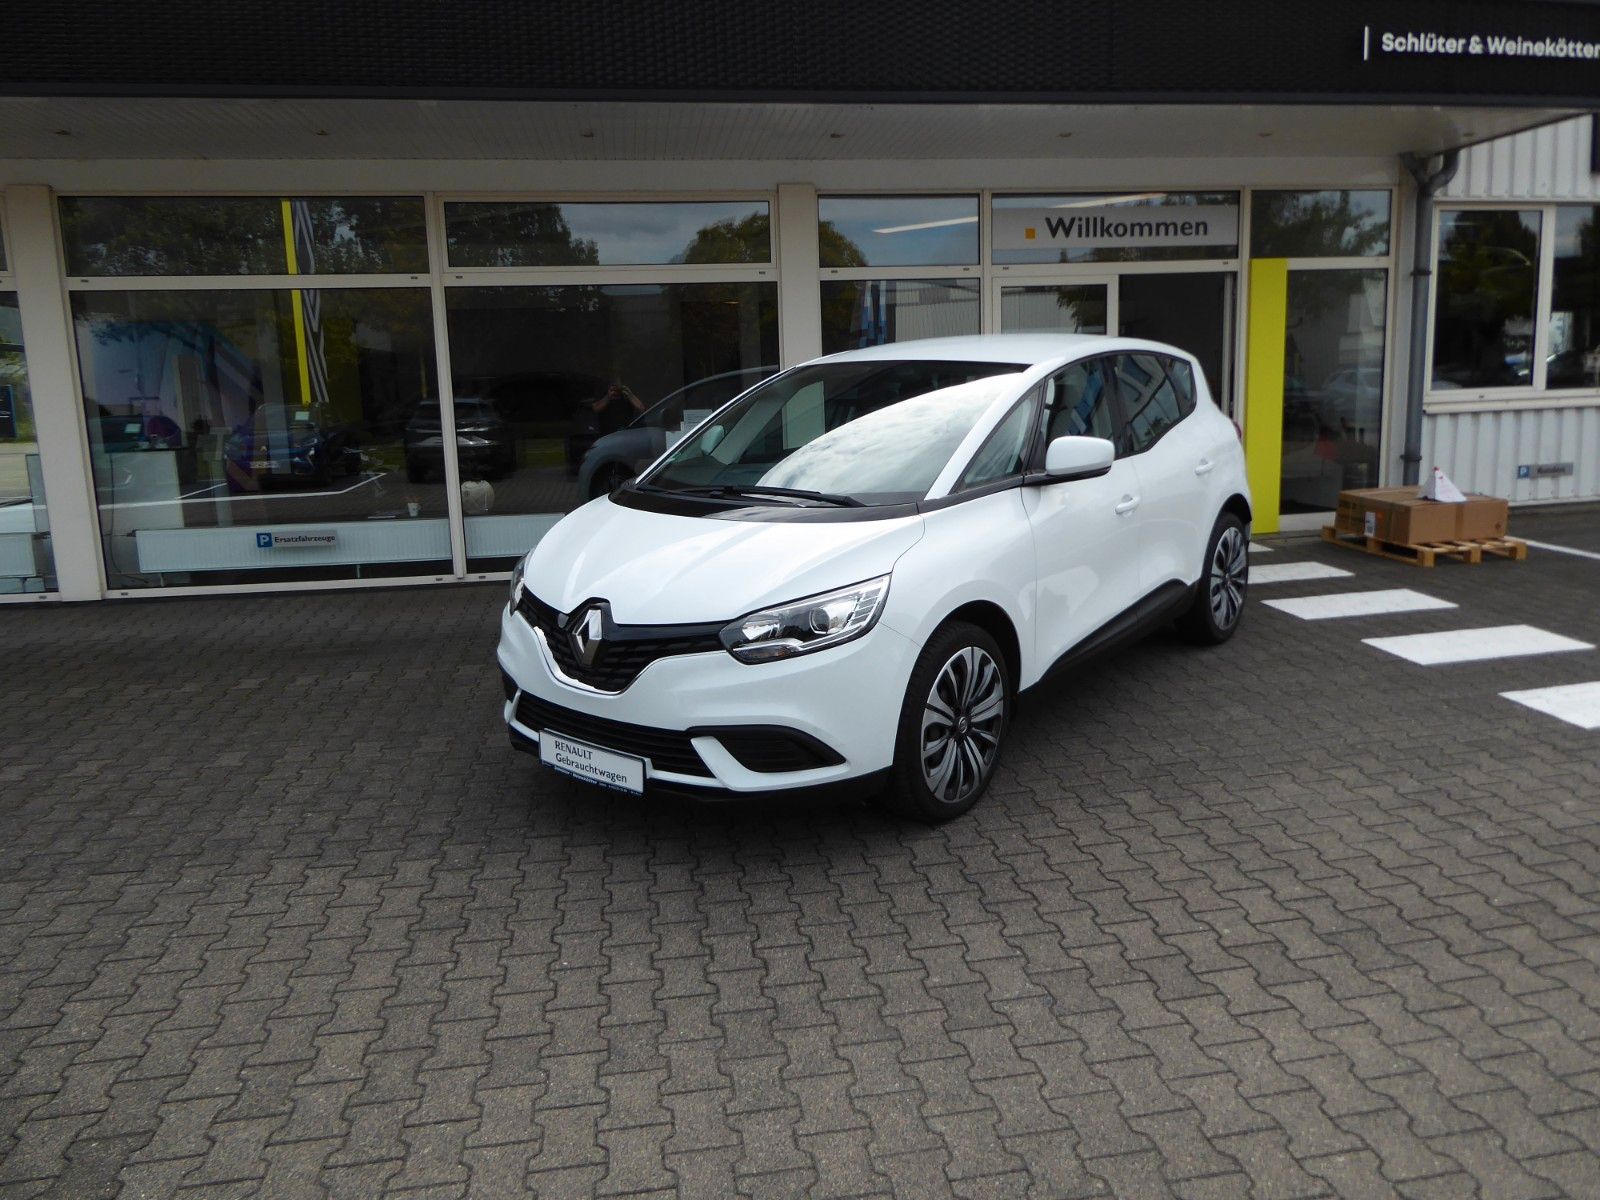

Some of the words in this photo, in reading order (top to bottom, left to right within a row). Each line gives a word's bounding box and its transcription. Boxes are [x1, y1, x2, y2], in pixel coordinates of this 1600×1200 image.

[1381, 32, 1466, 53] Schlüter
[1468, 35, 1483, 54] &
[1487, 36, 1600, 58] Weinekötter
[1045, 216, 1208, 238] Willkommen
[274, 535, 336, 543] Ersatzfahrzeuge
[554, 740, 593, 760] RENAULT
[555, 753, 628, 783] Gebrauchtwagen
